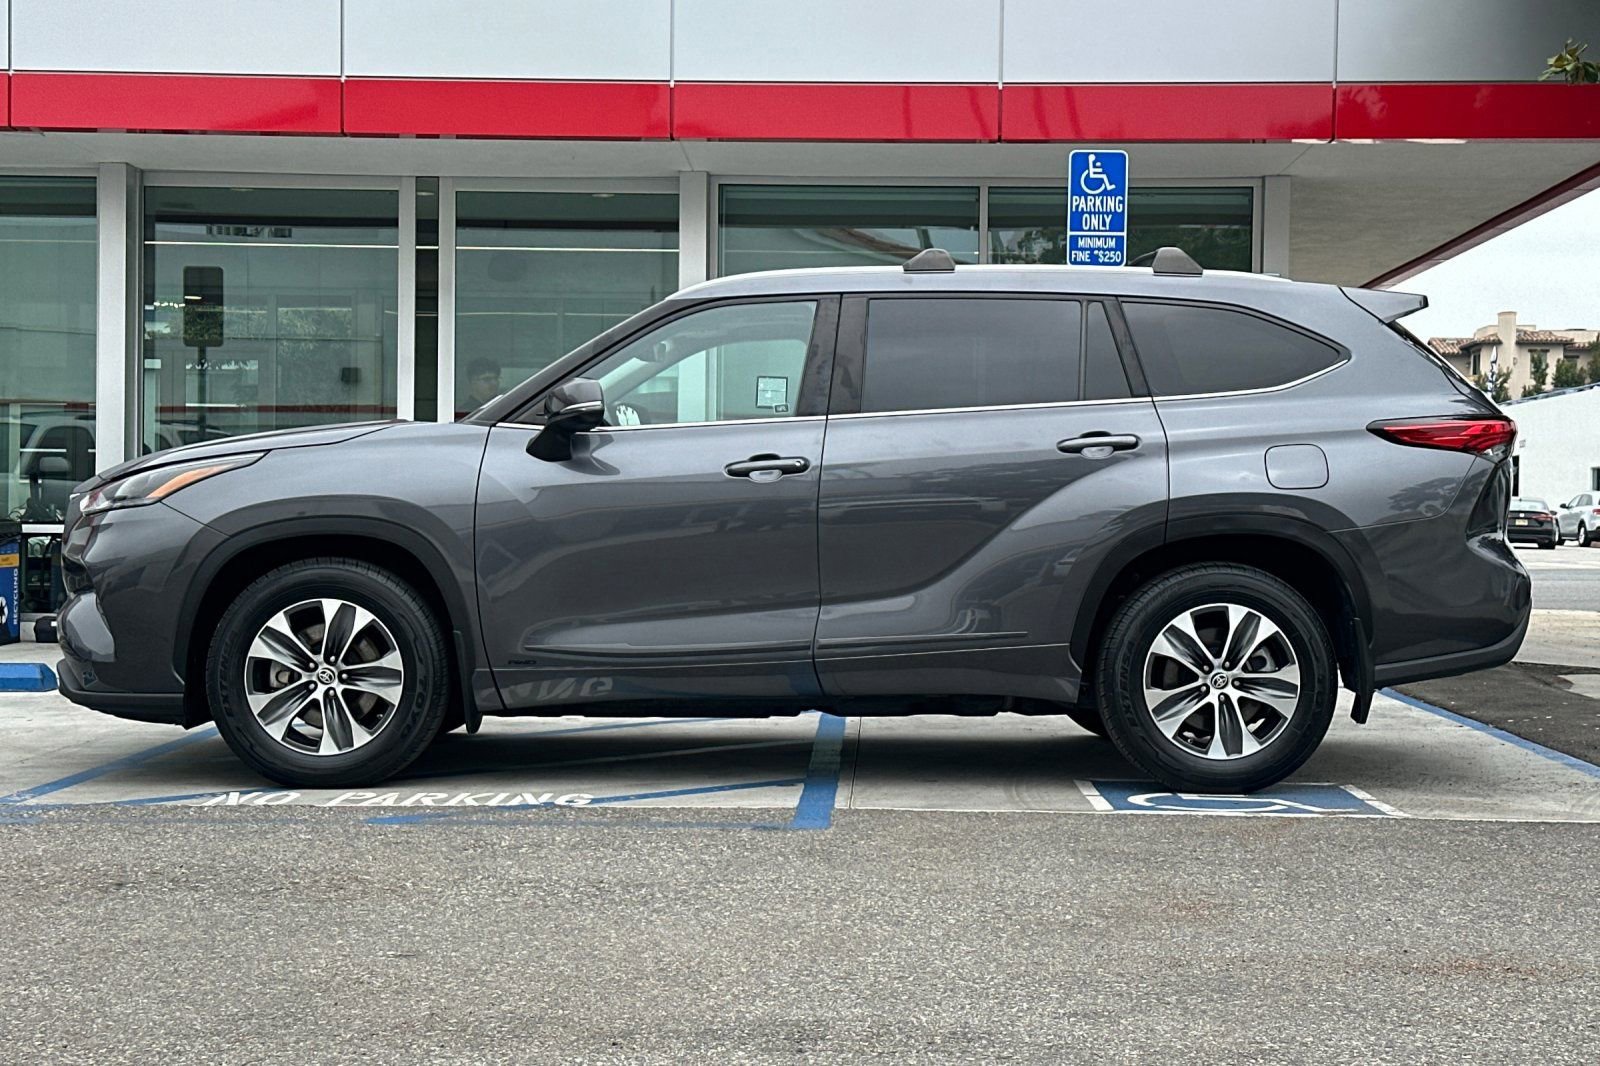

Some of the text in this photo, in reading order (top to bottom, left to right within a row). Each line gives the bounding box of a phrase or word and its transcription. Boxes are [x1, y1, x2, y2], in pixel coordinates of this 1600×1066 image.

[1072, 196, 1123, 213] PARKING
[1082, 213, 1112, 231] ONLY
[1078, 237, 1116, 249] MINIMUM
[1071, 250, 1121, 263] FINE $250
[203, 791, 595, 807] NO PARKING
